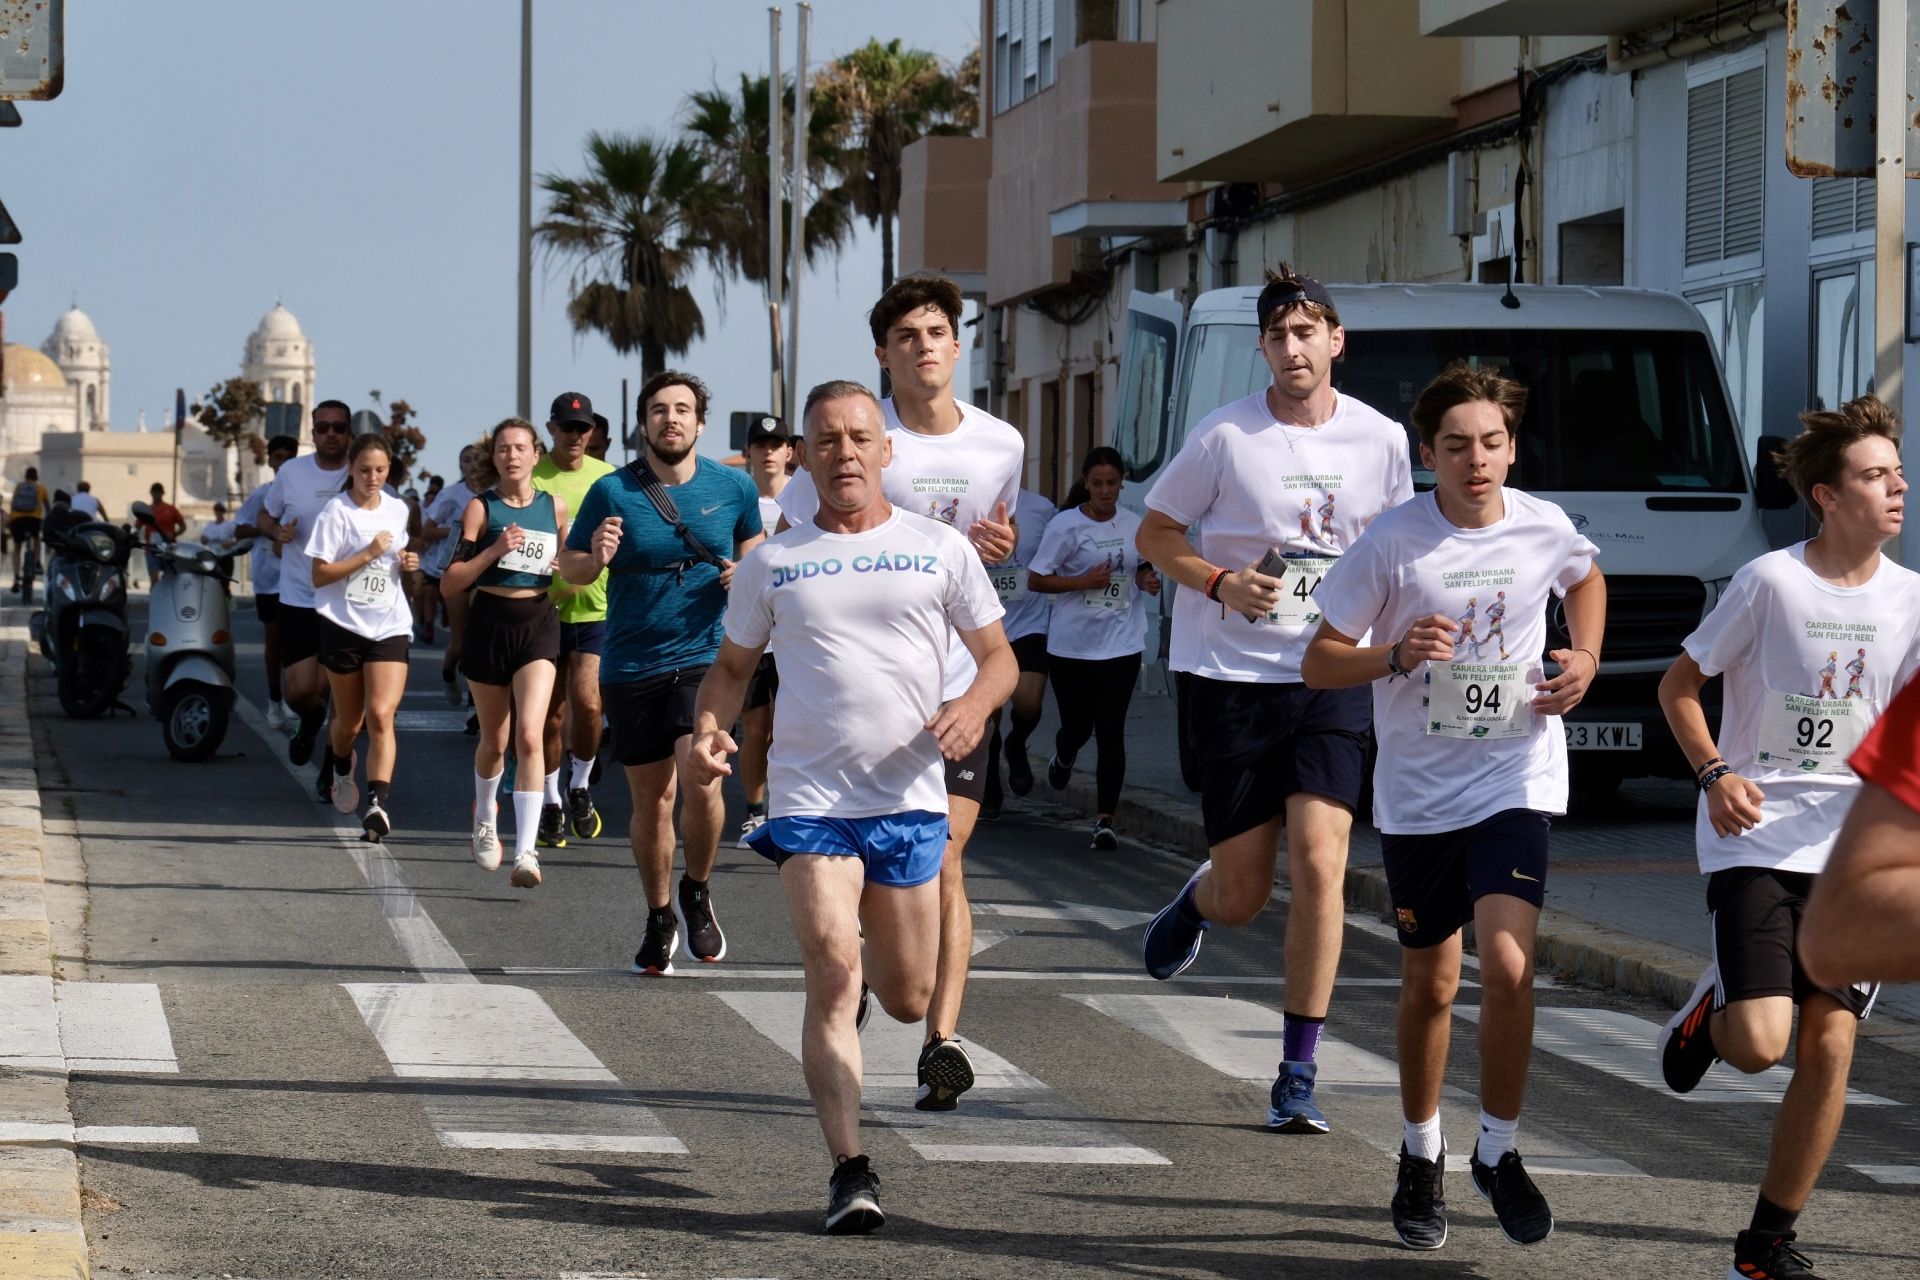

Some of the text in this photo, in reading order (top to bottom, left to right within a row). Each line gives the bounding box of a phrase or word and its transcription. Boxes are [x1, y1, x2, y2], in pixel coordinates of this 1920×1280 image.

[1281, 474, 1313, 482] CARRERA
[517, 541, 544, 560] 468
[772, 550, 938, 588] JUDO CÁDIZ
[1442, 568, 1516, 580] CARRERA URBANA
[362, 575, 386, 593] 103
[993, 576, 1017, 591] 455
[1444, 577, 1513, 589] SAN FELIPE NERI
[1805, 621, 1877, 632] CARRERA URBANA
[1807, 630, 1874, 642] SAN FELIPE NERI
[1451, 665, 1518, 673] CARRERA URBANA
[1452, 673, 1515, 681] SAN FELIPE NERI
[1465, 683, 1501, 714] 94
[1784, 695, 1853, 708] CARRERA URBANA
[1785, 704, 1850, 716] SAN FELIPE NERI
[1597, 726, 1638, 747] KWL
[1796, 717, 1834, 748] 92
